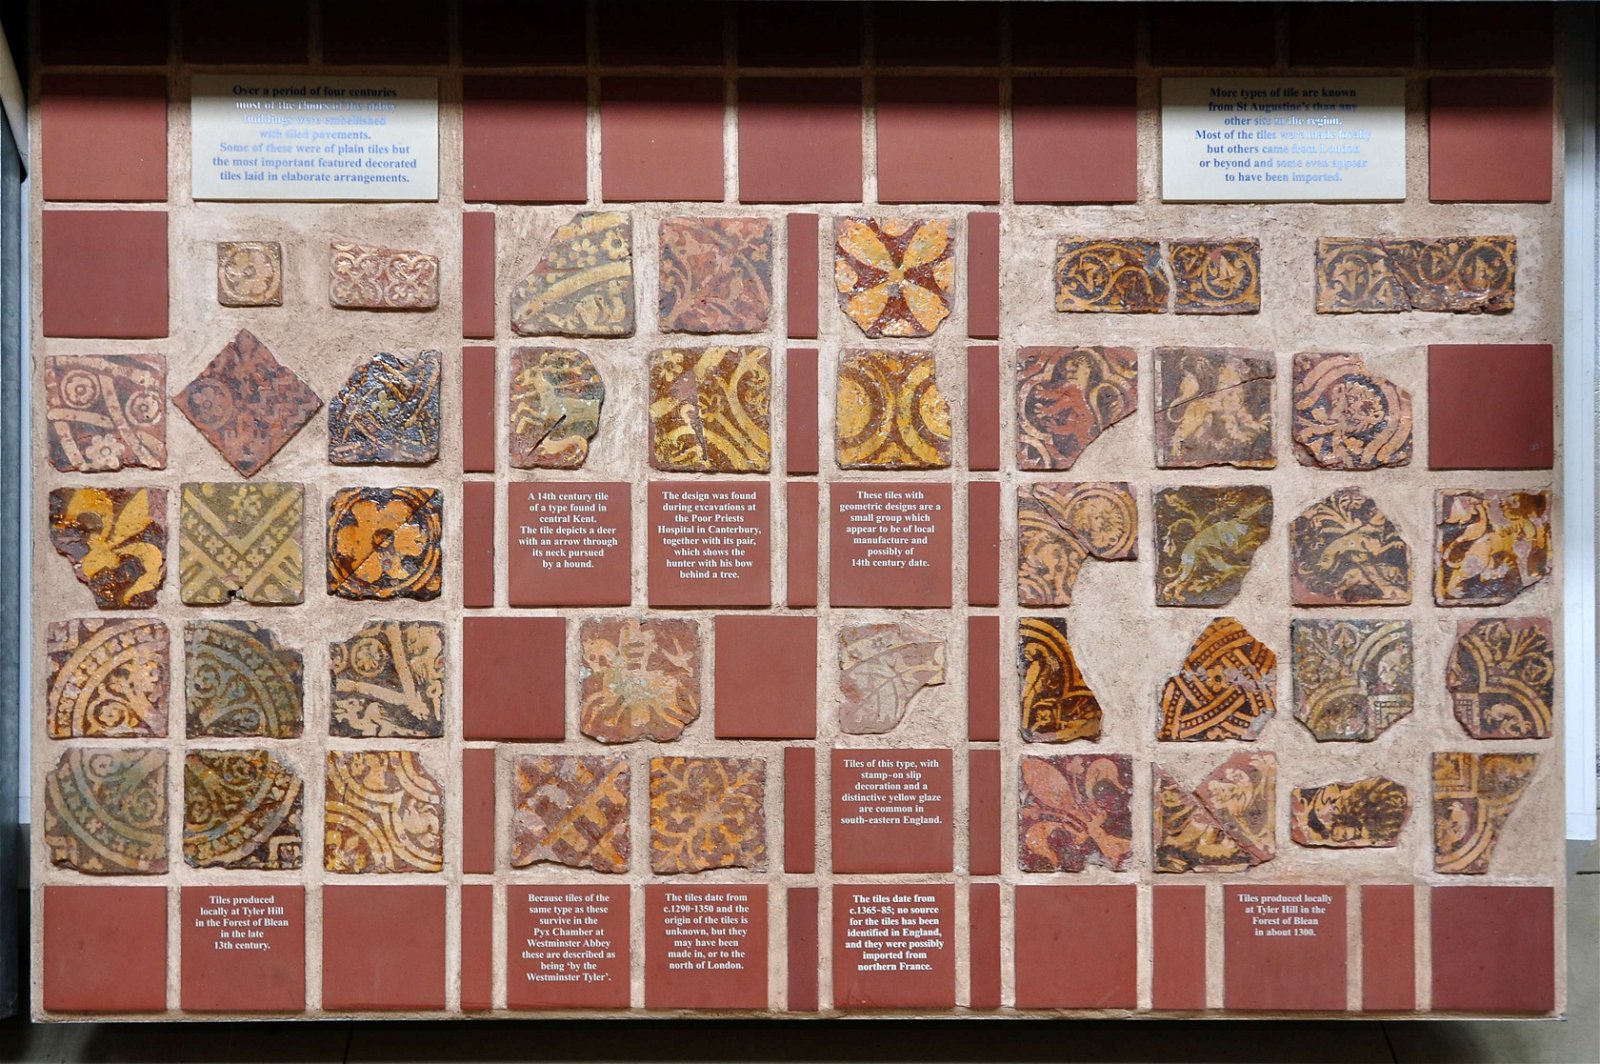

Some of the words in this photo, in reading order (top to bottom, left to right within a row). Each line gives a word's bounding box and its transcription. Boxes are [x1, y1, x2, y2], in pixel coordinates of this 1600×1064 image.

[233, 85, 260, 96] Over
[272, 86, 306, 98] period
[323, 87, 344, 97] four
[348, 87, 397, 97] centuries
[1210, 88, 1237, 97] More
[1241, 88, 1267, 99] types
[1283, 88, 1299, 97] tile
[1322, 88, 1356, 97] known
[1208, 102, 1233, 111] from
[1312, 102, 1336, 111] than
[1224, 116, 1251, 125] other
[1195, 130, 1221, 139] Most
[1257, 130, 1277, 139] tiles
[220, 142, 248, 152] Some
[296, 145, 320, 153] were
[338, 144, 364, 155] plain
[367, 144, 389, 154] tiles
[1227, 144, 1259, 153] others
[233, 158, 258, 167] most
[262, 157, 314, 169] important
[318, 157, 361, 167] featured
[365, 158, 417, 168] decorated
[1213, 158, 1251, 169] beyond
[220, 171, 241, 180] tiles
[245, 171, 264, 181] laid
[281, 171, 331, 181] elaborate
[333, 173, 410, 184] arrangements.
[1238, 172, 1262, 181] have
[1265, 172, 1289, 181] been
[538, 492, 556, 500] 14th
[559, 493, 592, 502] century
[682, 491, 709, 502] design
[731, 491, 756, 500] found
[857, 491, 882, 499] These
[885, 491, 902, 499] tiles
[905, 491, 924, 499] with
[549, 504, 568, 514] type
[570, 503, 595, 512] found
[663, 502, 692, 513] during
[694, 502, 745, 511] excavations
[840, 502, 883, 512] geometric
[885, 502, 917, 512] designs
[539, 514, 570, 523] central
[573, 514, 597, 523] Kent.
[692, 514, 712, 522] Poor
[715, 514, 744, 522] Priests
[850, 513, 874, 521] small
[876, 515, 902, 524] group
[904, 513, 930, 521] which
[556, 526, 587, 536] depicts
[597, 526, 616, 534] deer
[658, 525, 694, 535] Hospital
[708, 525, 761, 535] Canterbury,
[846, 526, 877, 535] appear
[914, 524, 935, 533] local
[518, 537, 538, 545] with
[583, 537, 618, 547] through
[663, 536, 699, 546] together
[702, 536, 721, 545] with
[736, 538, 756, 547] pair,
[853, 535, 909, 544] manufacture
[546, 548, 566, 557] neck
[568, 548, 604, 558] pursued
[674, 548, 700, 556] which
[703, 548, 729, 556] shows
[868, 547, 902, 557] possibly
[564, 559, 594, 568] hound.
[666, 559, 696, 567] hunter
[698, 559, 717, 567] with
[852, 558, 870, 566] 14th
[873, 559, 906, 568] century
[908, 558, 930, 566] date.
[680, 570, 710, 578] behind
[843, 759, 864, 768] Tiles
[896, 760, 918, 769] type,
[920, 759, 939, 767] with
[861, 772, 903, 783] stamp-on
[855, 782, 901, 790] decoration
[842, 793, 886, 801] distinctive
[889, 793, 916, 803] yellow
[919, 793, 941, 803] glaze
[841, 815, 900, 824] south-eastern
[903, 815, 942, 826] England.
[209, 895, 231, 904] Tiles
[233, 895, 274, 906] produced
[528, 893, 563, 902] Because
[565, 893, 583, 902] tiles
[685, 893, 702, 901] tiles
[704, 893, 724, 901] date
[726, 893, 747, 901] from
[872, 894, 890, 903] tiles
[892, 894, 912, 903] date
[914, 894, 935, 902] from
[1238, 894, 1259, 902] Tiles
[1261, 894, 1302, 904] produced
[1304, 894, 1332, 904] locally
[200, 907, 227, 917] locally
[242, 907, 265, 917] Tyler
[554, 906, 572, 915] type
[586, 905, 608, 913] these
[663, 904, 714, 913] c.1290-1350
[849, 906, 895, 915] c.1365-85;
[1256, 905, 1279, 915] Tyler
[223, 918, 250, 927] Forest
[264, 918, 289, 926] Blean
[539, 916, 571, 925] survive
[664, 915, 691, 926] origin
[721, 915, 739, 924] tiles
[881, 917, 899, 925] tiles
[918, 916, 939, 925] been
[1253, 916, 1280, 925] Forest
[1294, 916, 1318, 925] Blean
[552, 927, 593, 936] Chamber
[665, 927, 709, 936] unknown,
[728, 927, 747, 937] they
[847, 928, 889, 937] identified
[902, 927, 942, 939] England,
[1266, 928, 1291, 936] about
[1294, 928, 1316, 936] 1300.
[215, 941, 233, 949] 13th
[235, 942, 271, 951] century.
[527, 938, 581, 947] Westminster
[583, 939, 610, 949] Abbey
[695, 938, 716, 946] have
[718, 938, 739, 947] been
[864, 939, 883, 950] they
[909, 939, 944, 950] possibly
[522, 950, 544, 958] these
[562, 950, 604, 958] described
[668, 949, 692, 958] made
[863, 950, 903, 961] imported
[905, 950, 927, 959] from
[541, 961, 565, 972] being
[669, 961, 693, 969] north
[708, 961, 744, 969] London.
[858, 962, 897, 971] northern
[899, 962, 933, 970] France.
[526, 973, 580, 981] Westminster
